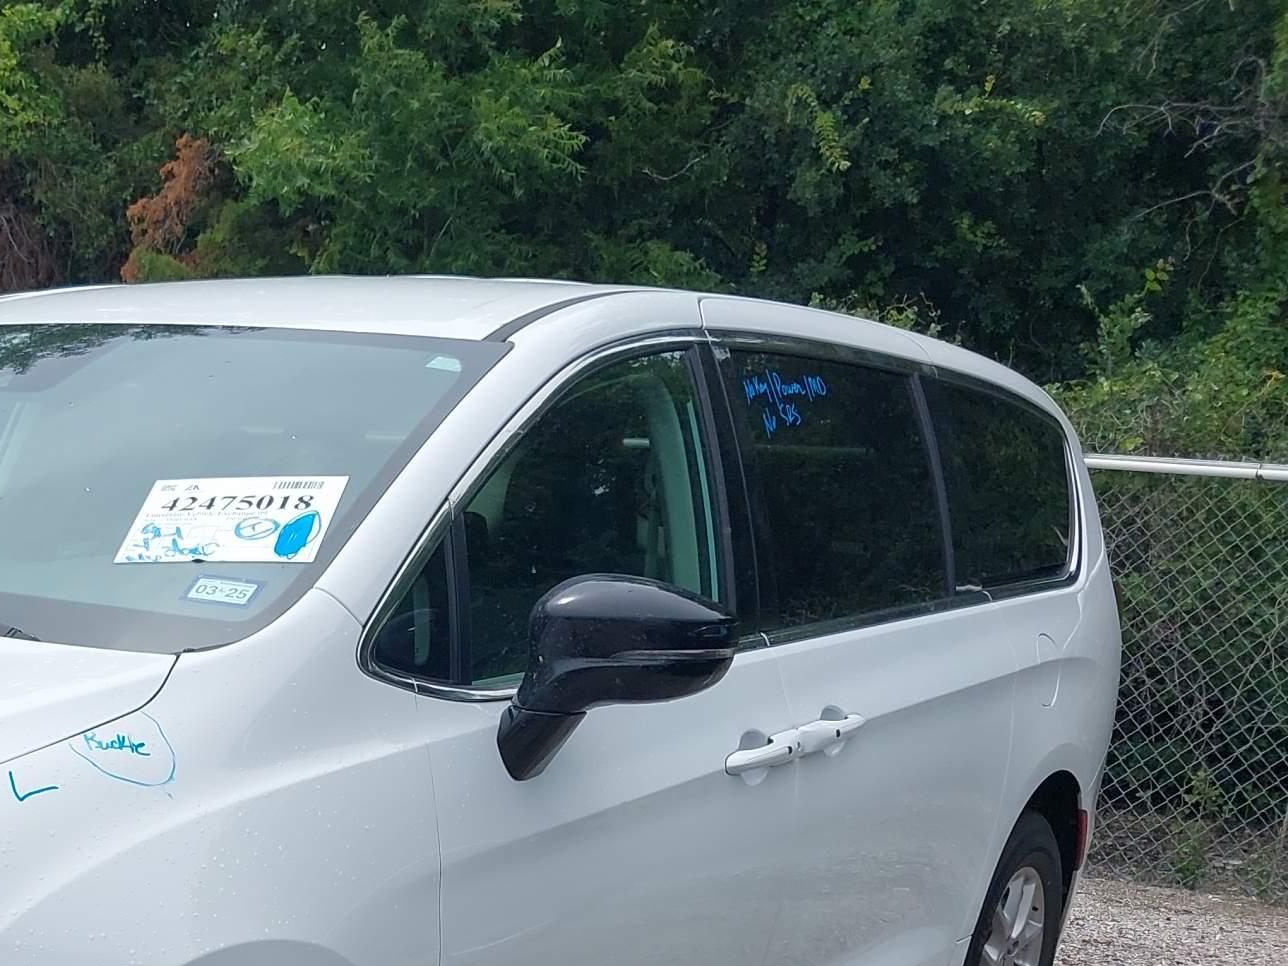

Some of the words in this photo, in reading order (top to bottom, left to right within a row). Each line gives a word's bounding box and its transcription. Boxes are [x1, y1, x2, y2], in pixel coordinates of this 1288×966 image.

[160, 494, 315, 512] 42475018
[195, 584, 218, 596] 03
[223, 587, 251, 600] 25
